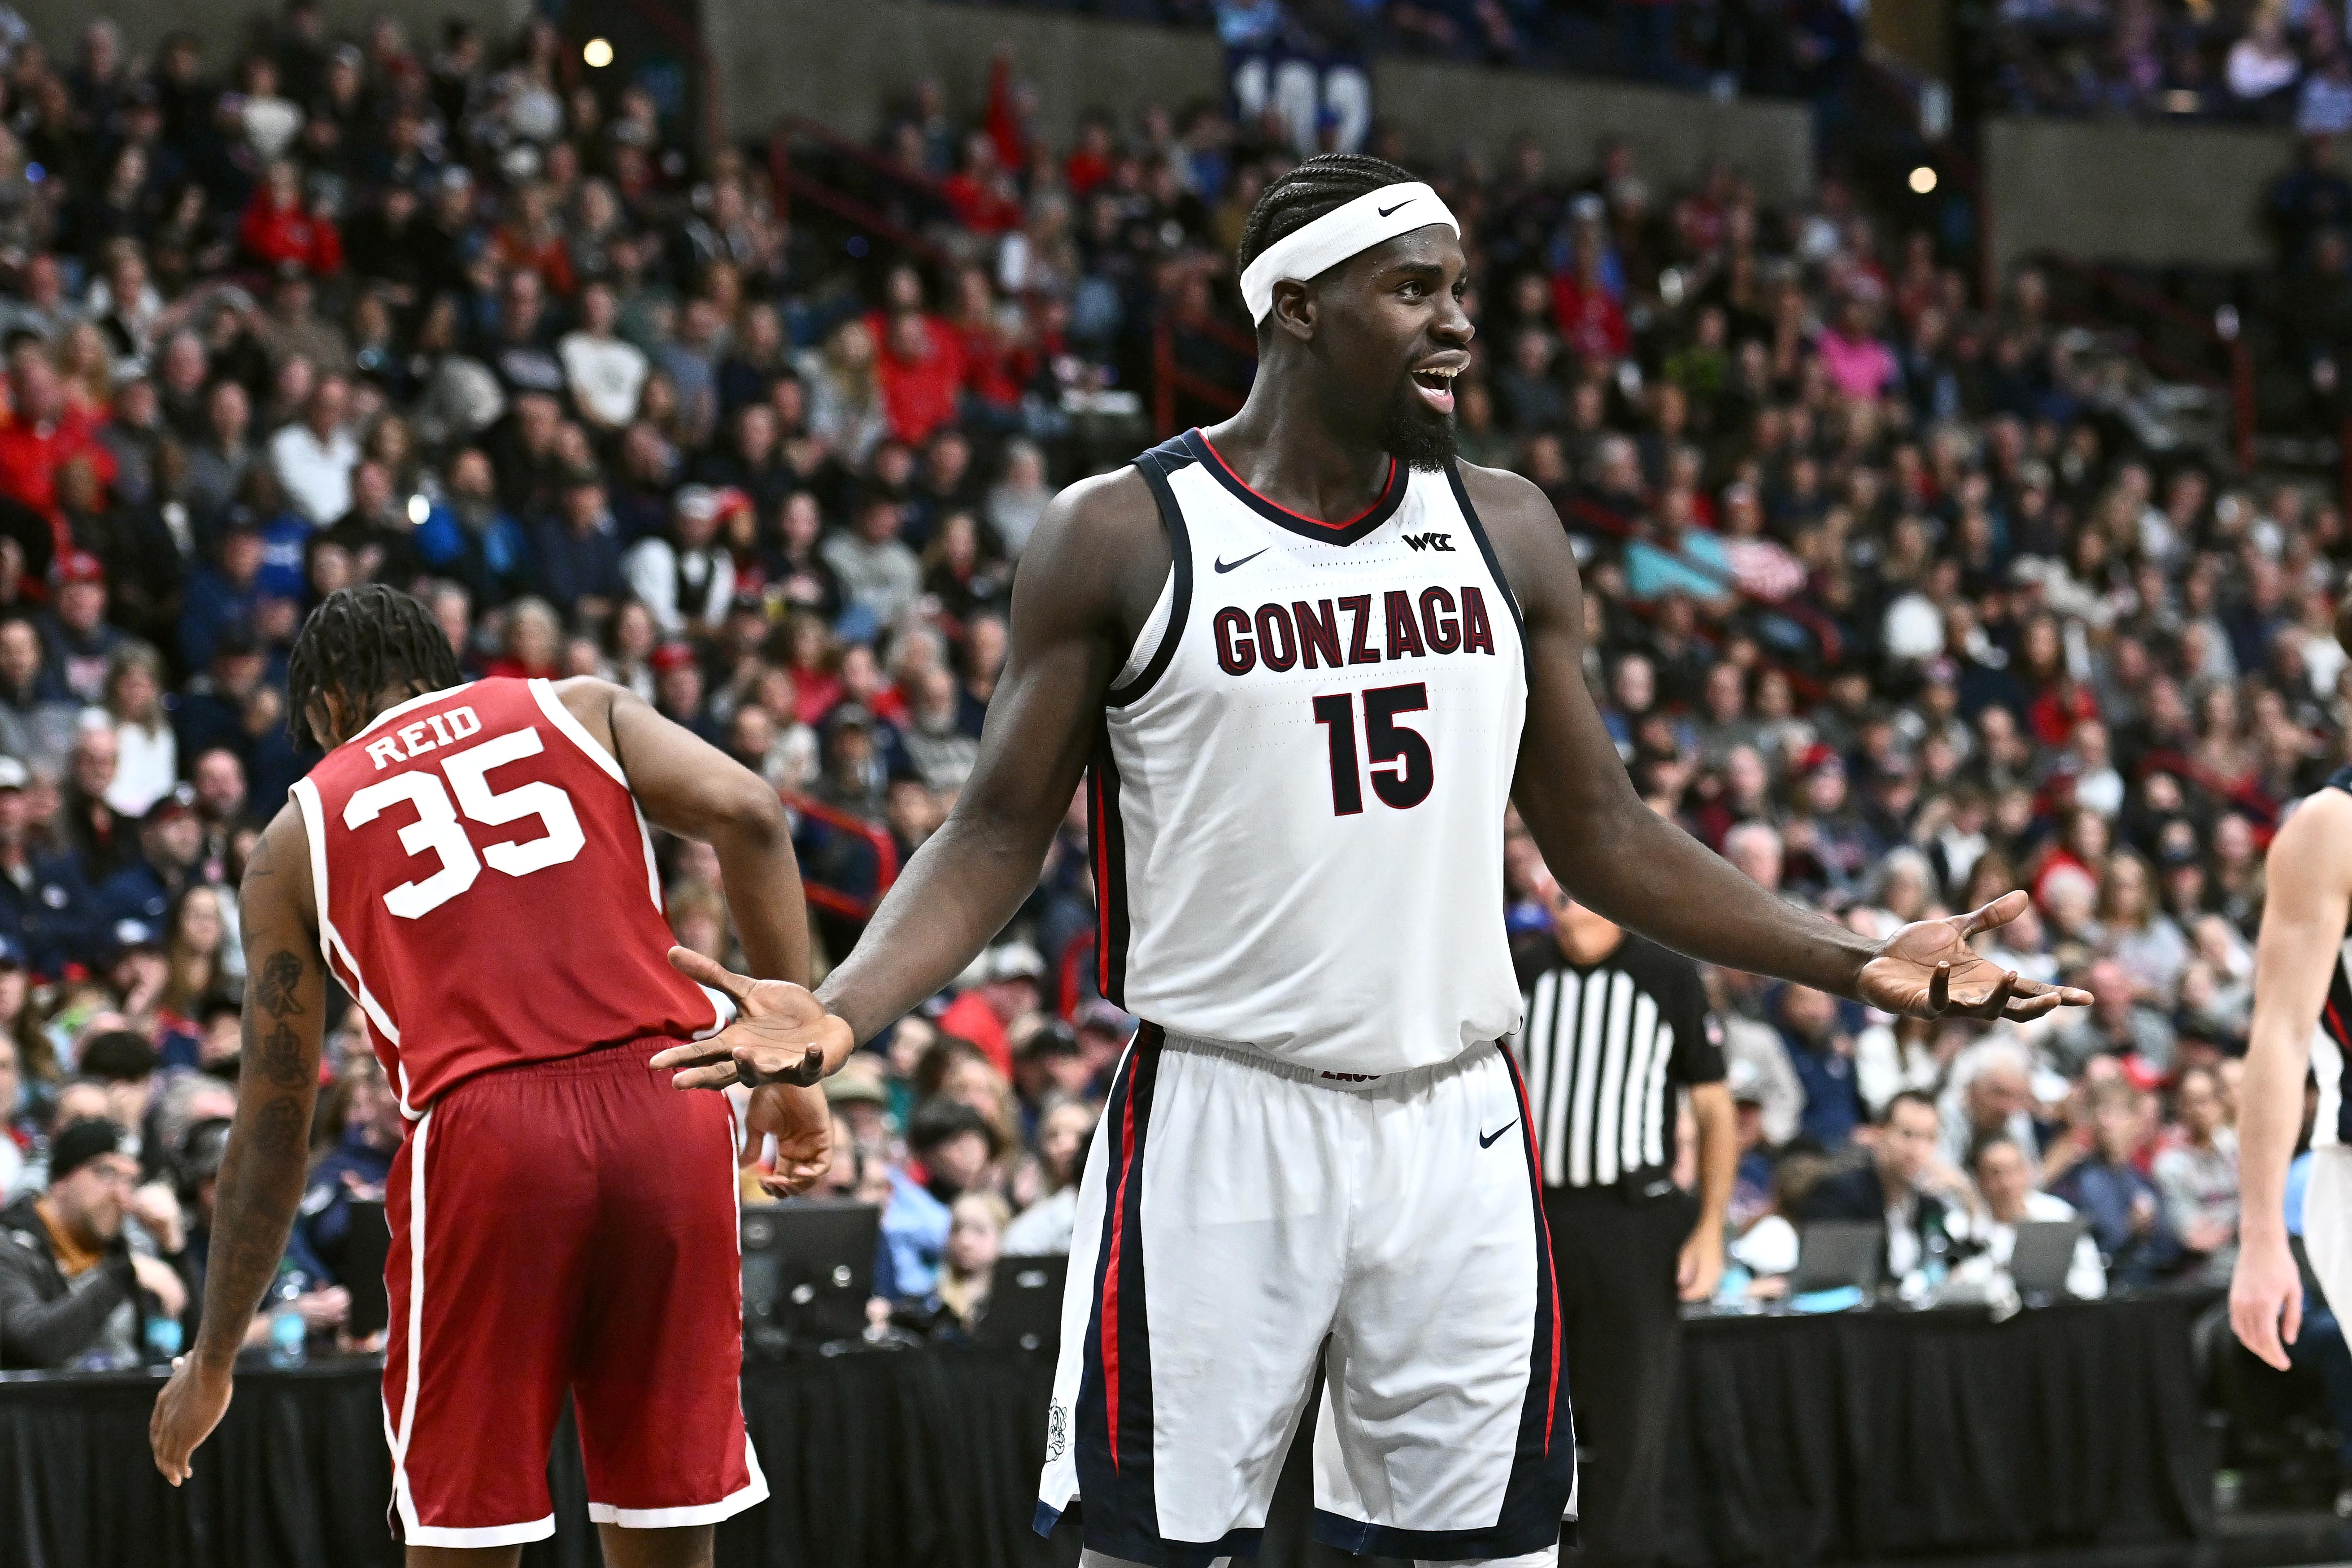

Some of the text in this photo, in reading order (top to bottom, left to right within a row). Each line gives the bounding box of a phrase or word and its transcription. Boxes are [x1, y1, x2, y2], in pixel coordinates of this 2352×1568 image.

[1402, 532, 1456, 552] WCC
[1214, 586, 1495, 675] GONZAGA
[365, 706, 482, 770] REID
[1313, 683, 1433, 816] 15
[343, 726, 585, 919] 35
